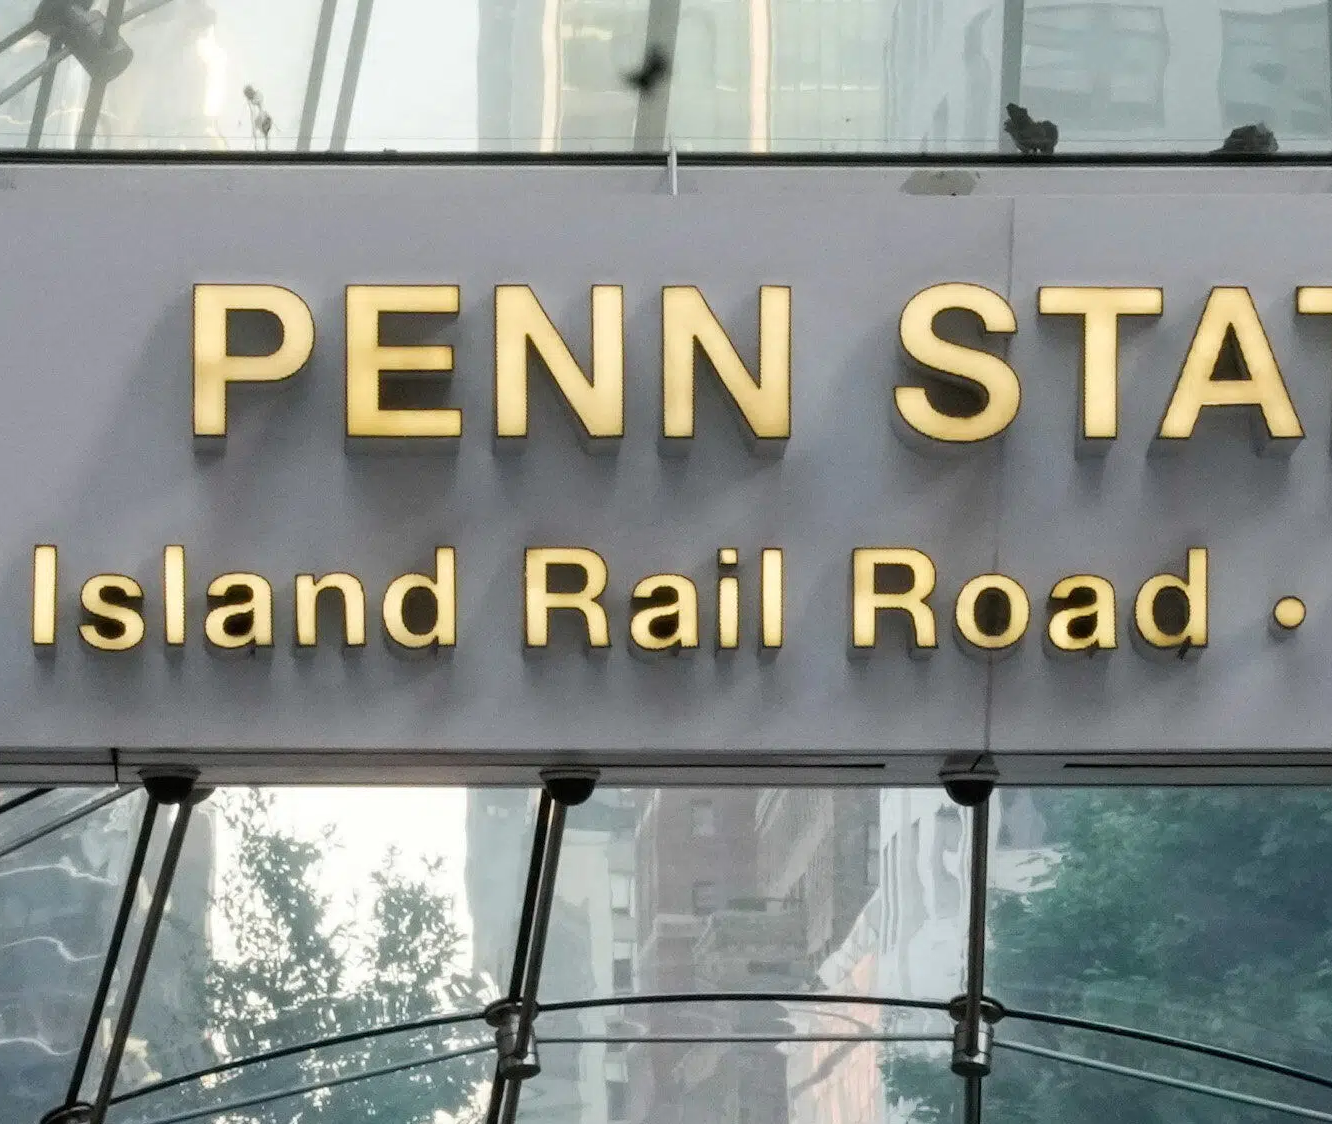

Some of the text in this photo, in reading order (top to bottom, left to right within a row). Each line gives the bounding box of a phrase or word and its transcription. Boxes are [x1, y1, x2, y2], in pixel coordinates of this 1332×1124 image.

[193, 284, 791, 438] PENN
[32, 545, 457, 650] Island
[524, 547, 784, 650] Rail
[851, 547, 1208, 650] Road
